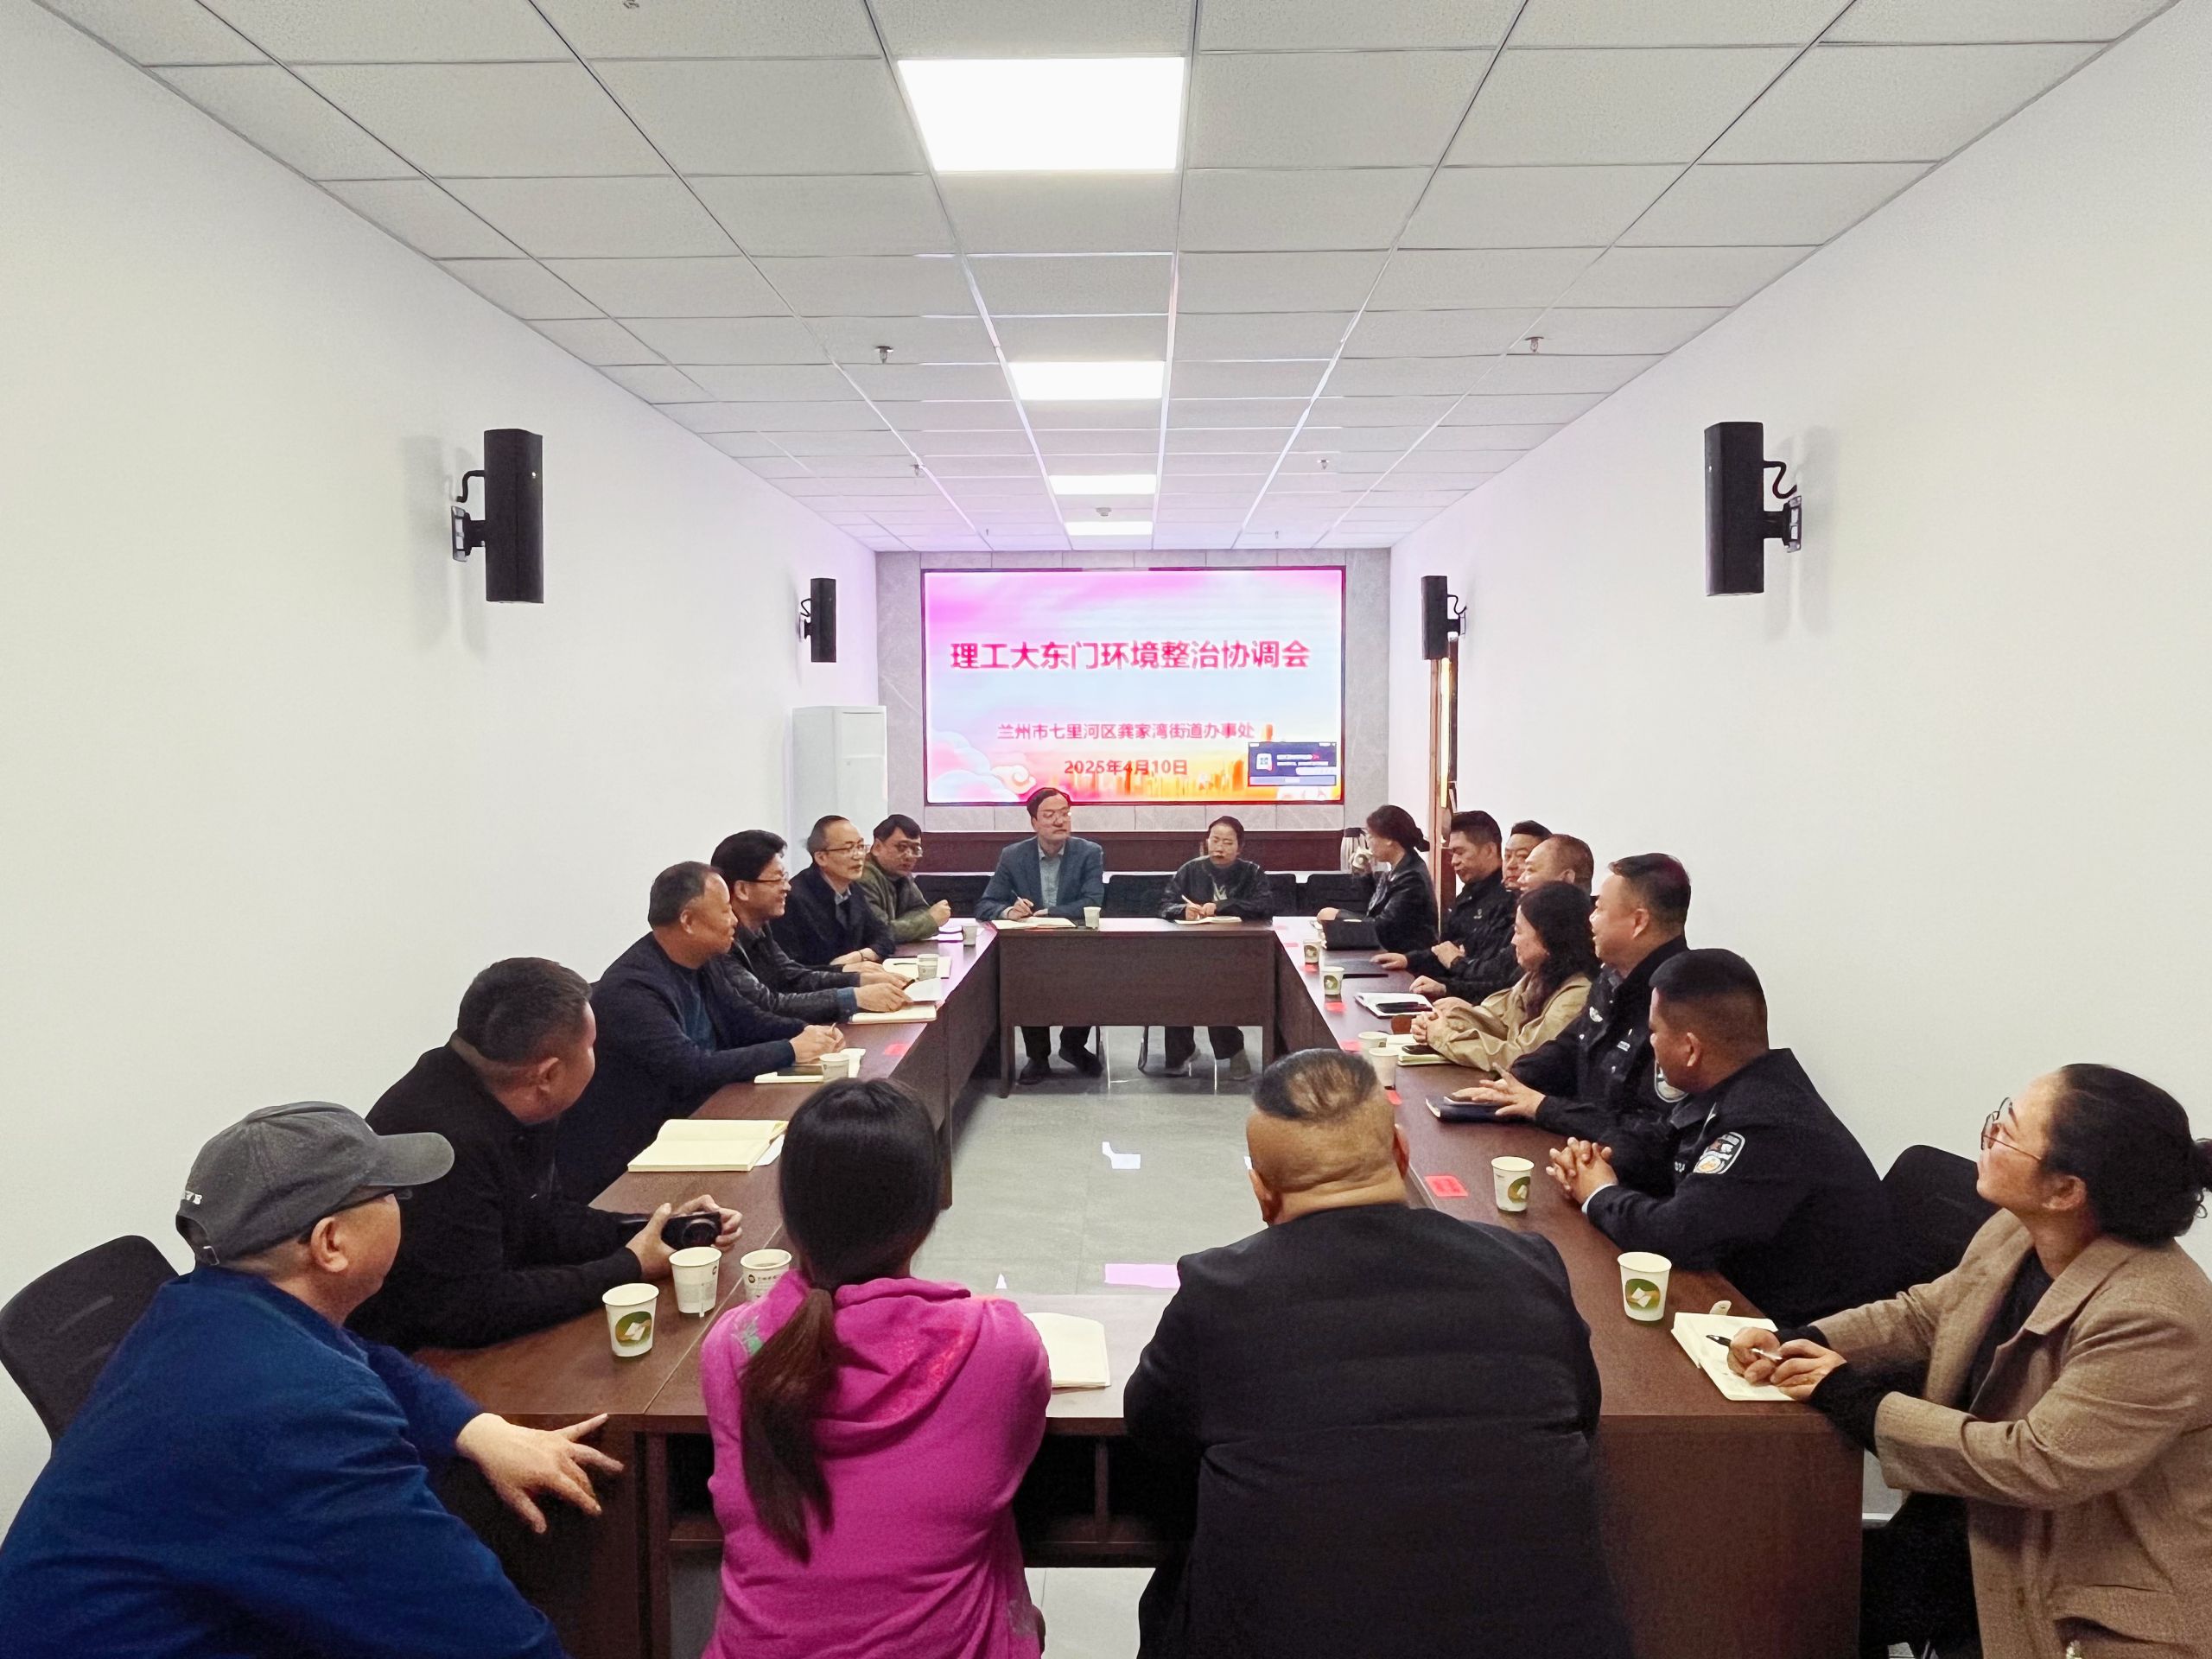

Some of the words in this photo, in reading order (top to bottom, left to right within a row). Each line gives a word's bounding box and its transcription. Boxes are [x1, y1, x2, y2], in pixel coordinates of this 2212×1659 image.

[950, 640, 1311, 670] 理工大东门环境整治协调会
[997, 722, 1255, 740] 兰州市七里河区龚家湾街道办事处
[1064, 760, 1187, 775] 2025年4月10日
